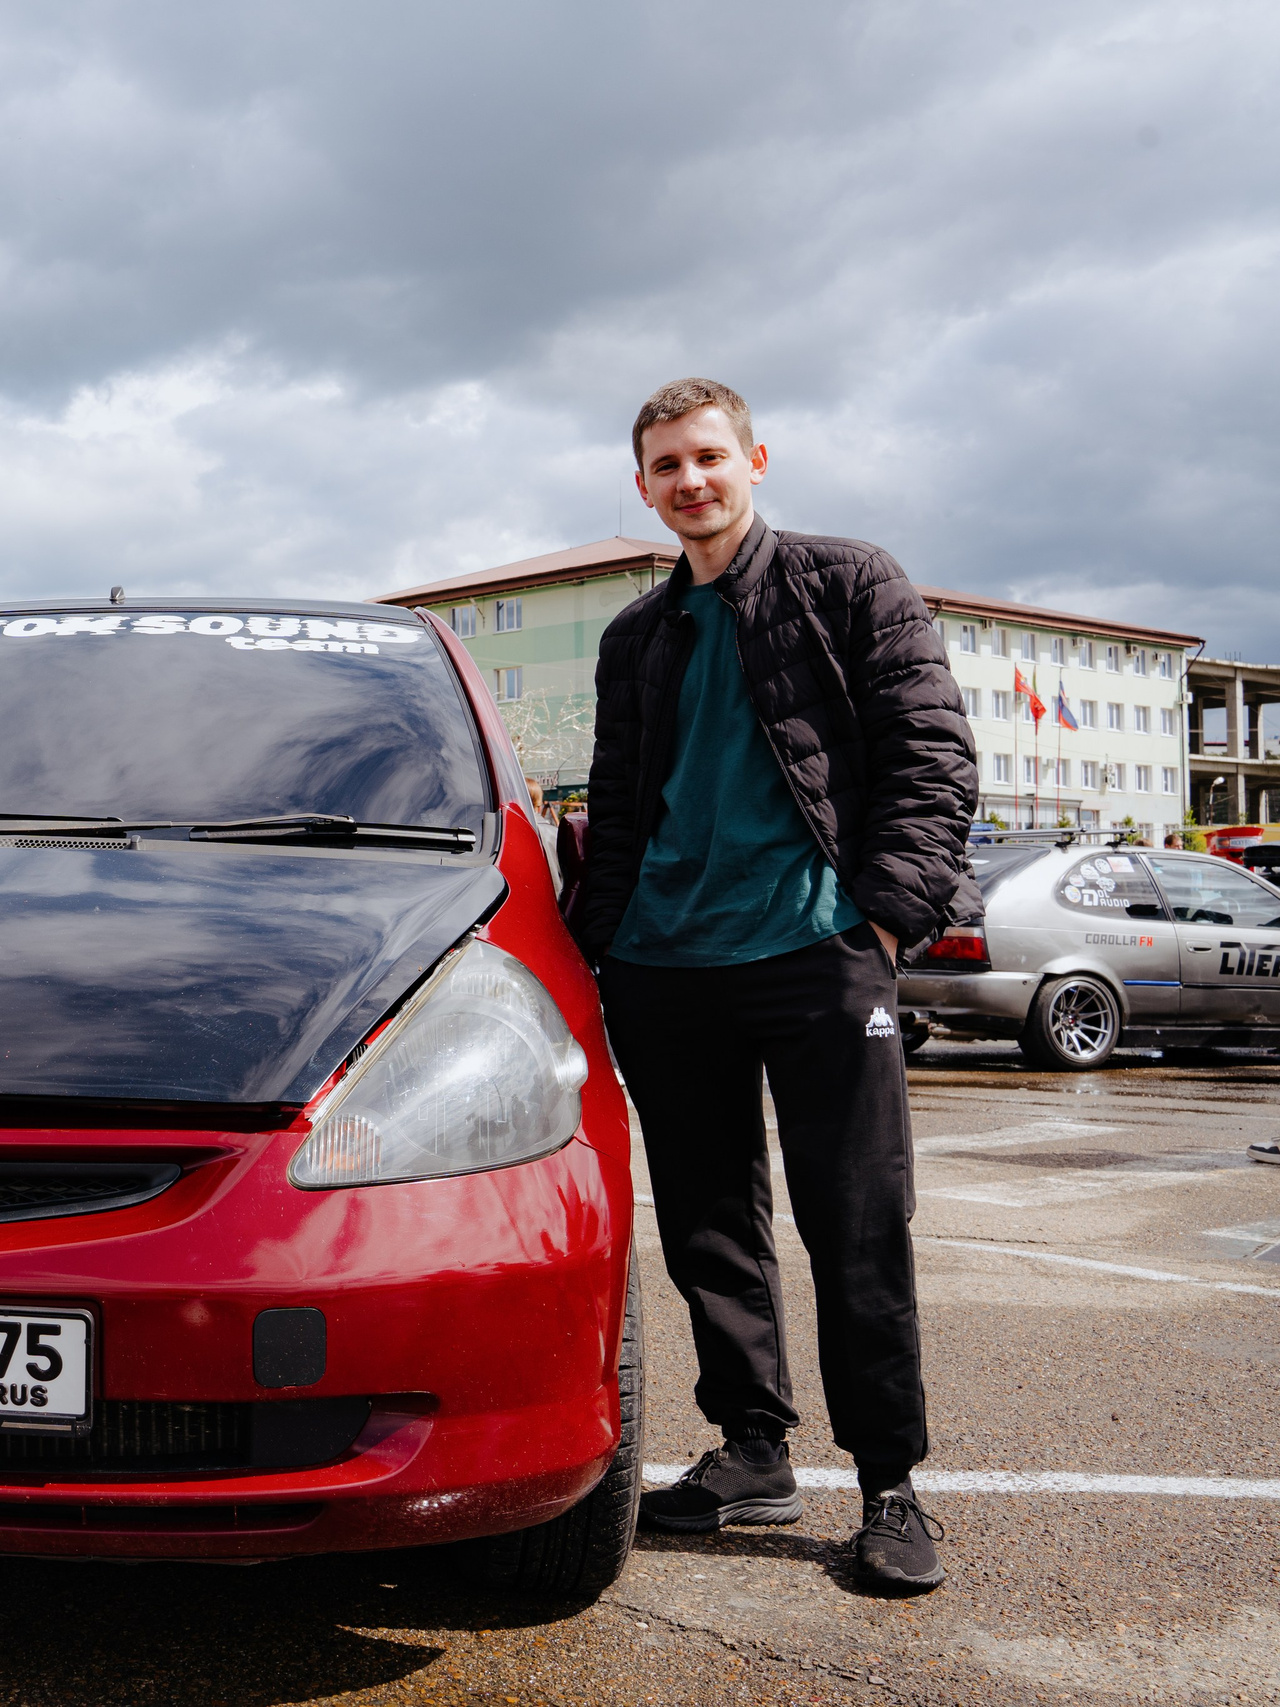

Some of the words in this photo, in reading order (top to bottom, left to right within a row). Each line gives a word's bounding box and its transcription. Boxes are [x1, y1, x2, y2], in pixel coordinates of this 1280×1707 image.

[225, 636, 380, 655] team
[1085, 933, 1137, 947] COROLLA
[1139, 936, 1153, 947] FX
